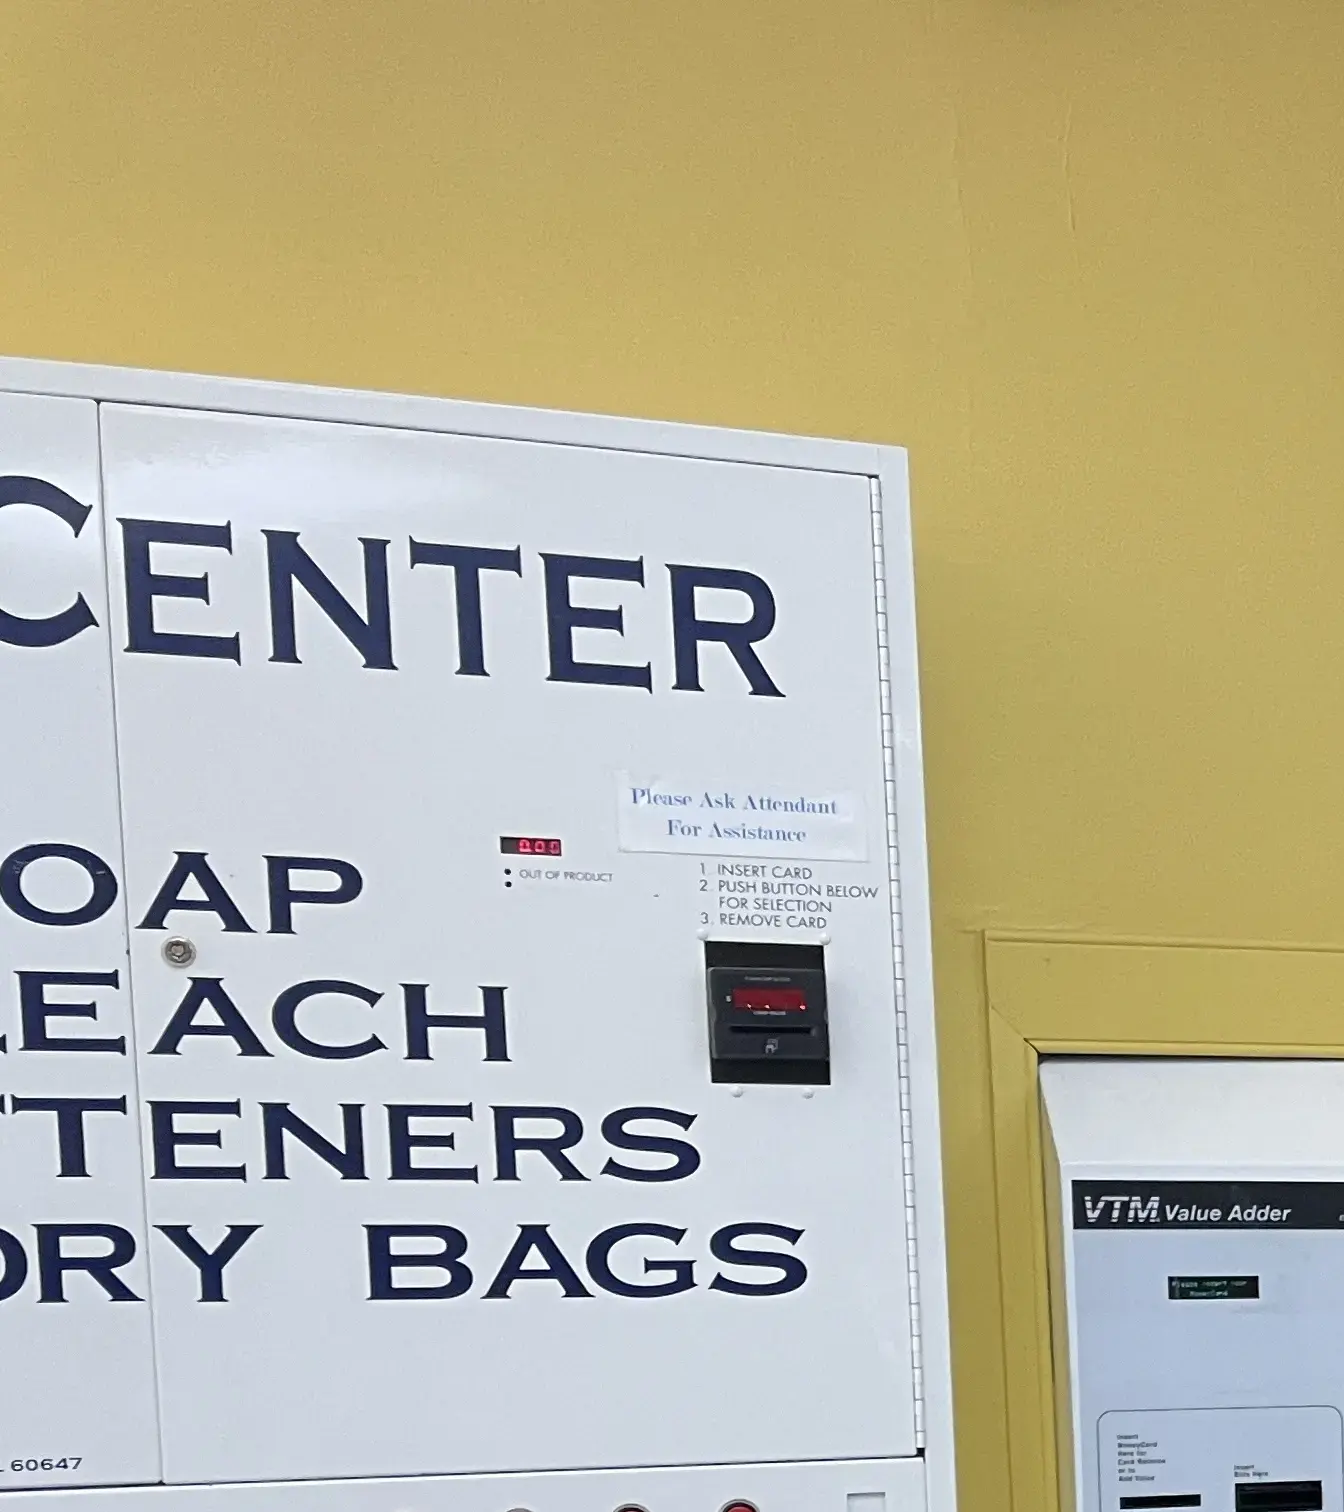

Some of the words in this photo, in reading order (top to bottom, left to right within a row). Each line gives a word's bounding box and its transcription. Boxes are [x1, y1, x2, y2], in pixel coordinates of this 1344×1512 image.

[0, 474, 786, 699] CENTER
[631, 787, 693, 806] Please
[699, 791, 736, 810] Ask
[743, 795, 838, 815] Attendant
[667, 819, 703, 837] For
[708, 822, 807, 842] Assistance
[519, 869, 542, 879] OUT
[545, 871, 561, 880] OF
[563, 871, 613, 882] PRODUCT
[717, 864, 767, 878] INSERT
[771, 866, 813, 880] CARD
[718, 879, 757, 894] PUSH
[761, 881, 822, 896] BUTTON
[826, 884, 879, 898] BELOW
[719, 896, 749, 910] FOR
[753, 898, 832, 914] SELECTION
[719, 913, 781, 928] REMOVE
[786, 915, 828, 930] CARD
[0, 969, 513, 1062] EACH
[0, 1094, 702, 1184] TENERS
[1083, 1196, 1160, 1223] VTM
[1164, 1204, 1222, 1223] Value
[1227, 1204, 1292, 1223] Adder
[0, 1223, 264, 1304] RY
[363, 1222, 809, 1301] BAGS
[10, 1457, 83, 1472] 60647
